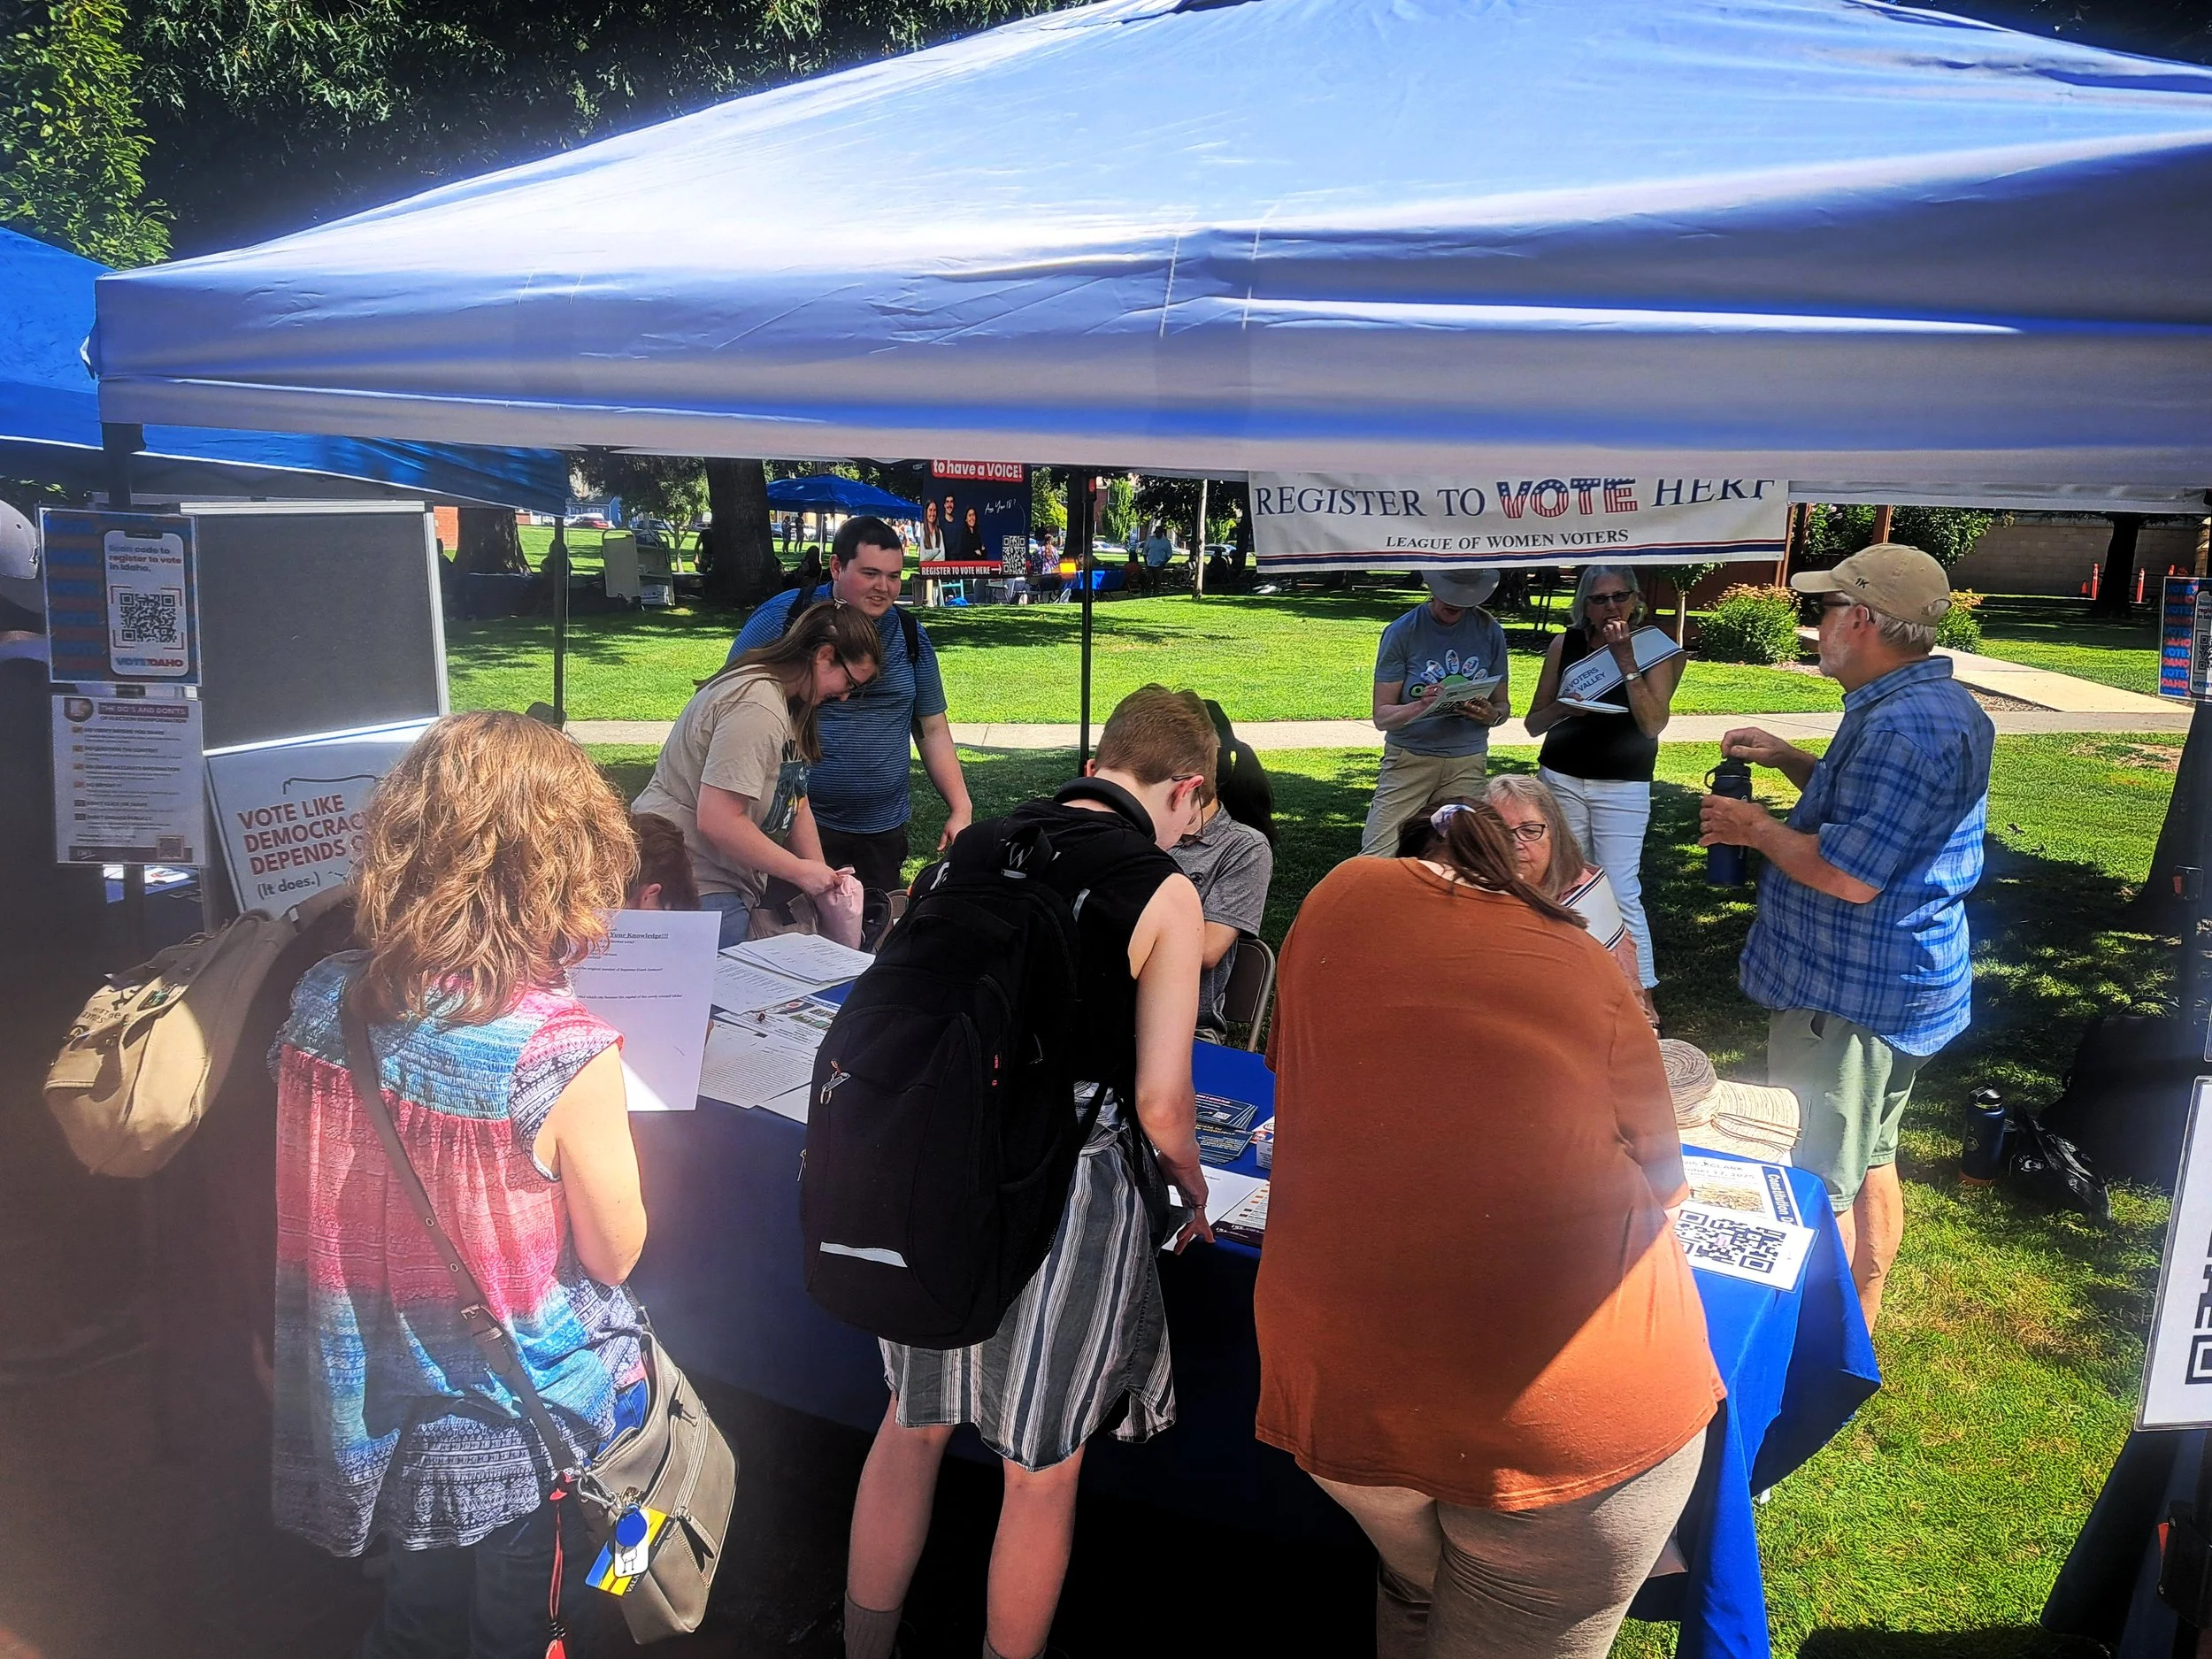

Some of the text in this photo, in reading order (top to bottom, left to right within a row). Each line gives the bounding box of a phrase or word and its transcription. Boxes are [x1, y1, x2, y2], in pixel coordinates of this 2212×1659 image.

[947, 460, 976, 475] have
[978, 466, 985, 476] a
[987, 463, 1023, 479] VOICE!
[1254, 486, 1428, 517] REGISTER
[1436, 488, 1486, 517] TO
[1495, 477, 1639, 519] VOTE
[1386, 529, 1630, 550] LEAGUE OF WOMEN VOTERS
[109, 554, 147, 564] register
[120, 564, 151, 572] Idaho.
[921, 565, 991, 576] REGISTER TO VOTE HERE
[1569, 667, 1599, 687] VOTERS
[1577, 672, 1606, 691] VALLEY
[237, 794, 346, 830] VOTE LIKE
[249, 839, 347, 876] DEPENDS
[257, 871, 321, 901] (It does.)
